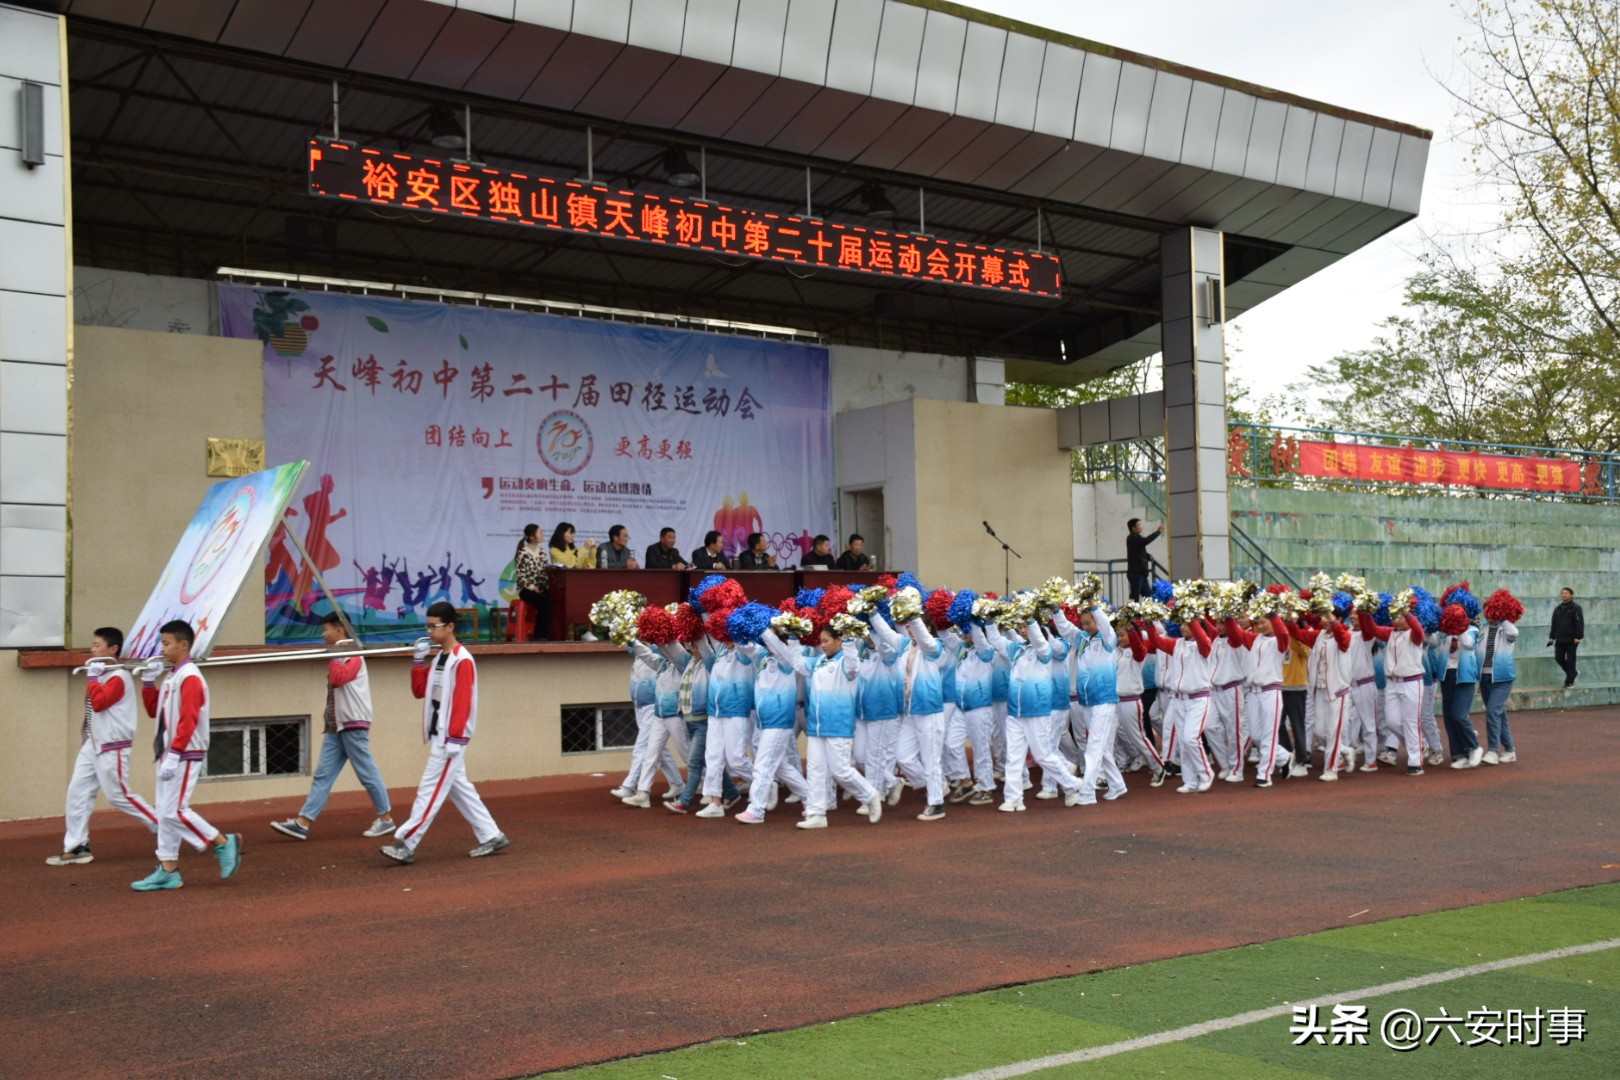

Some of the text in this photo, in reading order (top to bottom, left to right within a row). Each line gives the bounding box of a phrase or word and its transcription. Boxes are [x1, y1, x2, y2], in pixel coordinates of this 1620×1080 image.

[362, 158, 1031, 288] 裕安区独山镇天峰初中第二十届运动会开幕式
[312, 353, 764, 421] 天峰初中第二十届田径运动会
[425, 424, 513, 448] 团结向上
[614, 434, 694, 460] 更高更强
[1323, 449, 1357, 473] 团结
[1369, 452, 1402, 475] 友谊
[1414, 456, 1445, 478] 进步
[1457, 458, 1487, 481] 更快
[1496, 461, 1524, 484] 更高
[1536, 464, 1563, 485] 更强
